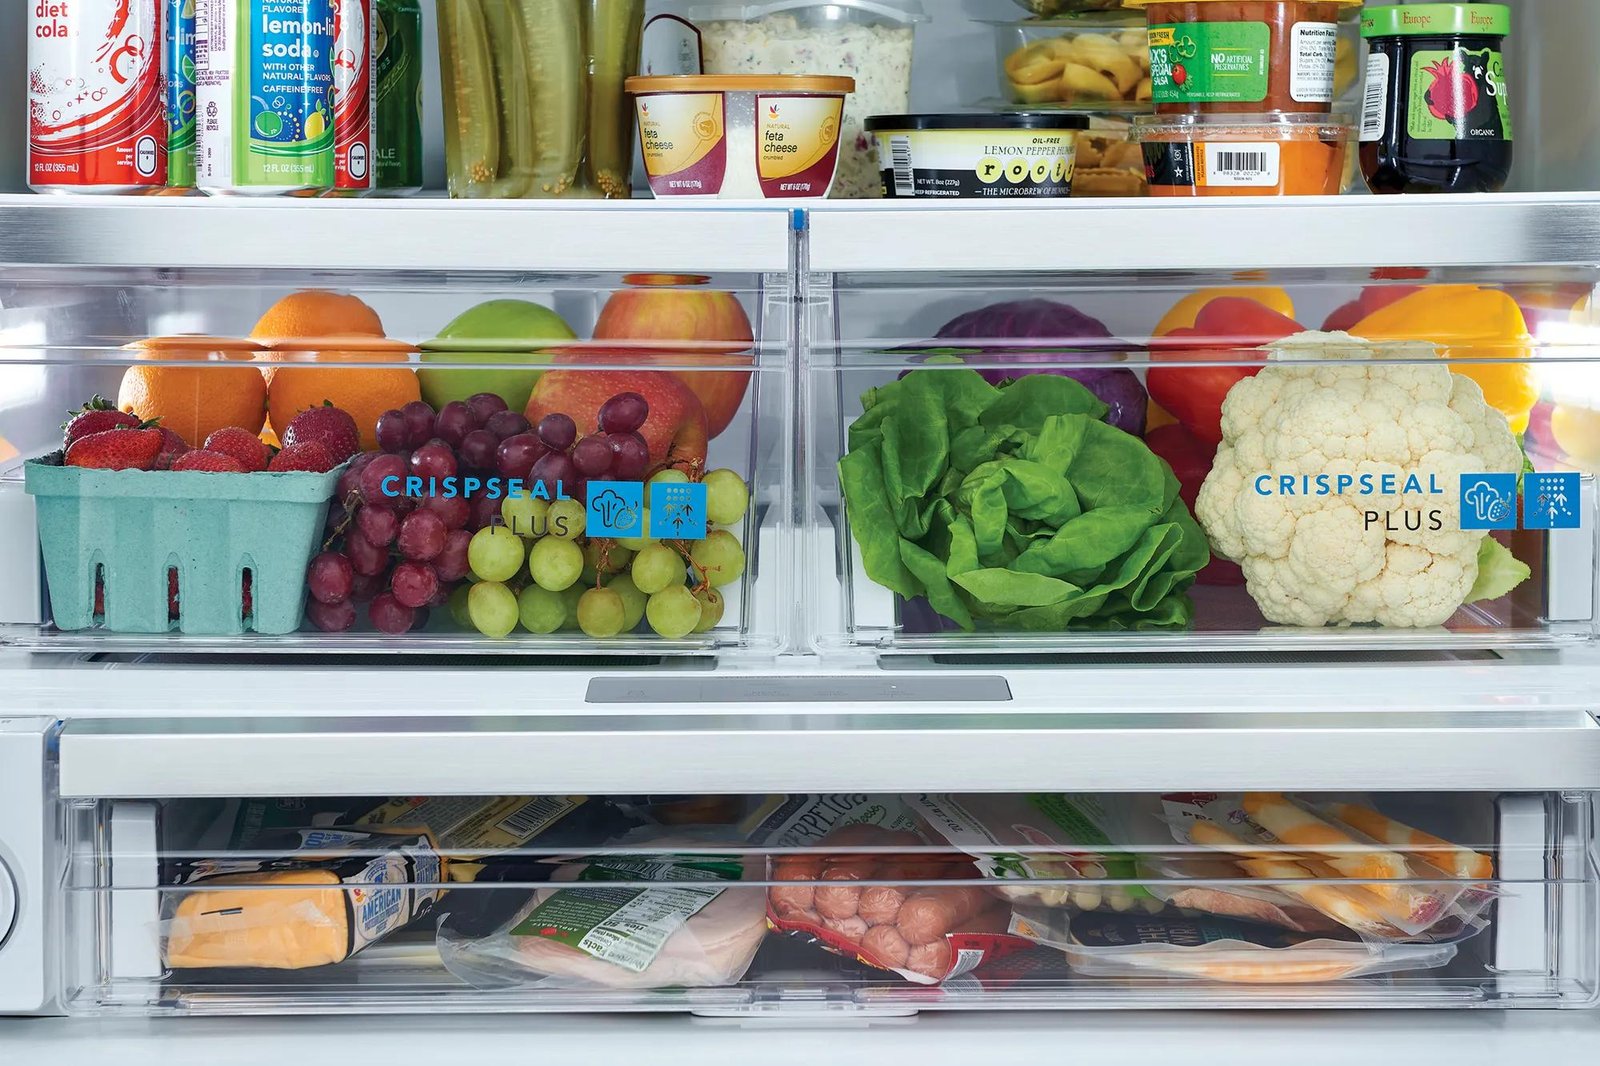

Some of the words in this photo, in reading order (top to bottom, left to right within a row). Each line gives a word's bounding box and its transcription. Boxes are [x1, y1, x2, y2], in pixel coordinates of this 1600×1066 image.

[36, 0, 68, 17] diet
[1402, 12, 1431, 28] Europe
[36, 19, 68, 37] cola
[262, 38, 312, 58] soda
[1210, 53, 1226, 64] NO
[1226, 55, 1253, 64] ARTIFICIAL
[262, 63, 287, 71] WITH
[288, 63, 315, 72] OTHER
[262, 72, 304, 80] NATURAL
[305, 73, 331, 82] FLAVORS
[1153, 76, 1169, 86] SALSA
[262, 85, 307, 94] CAFFEINE
[307, 86, 324, 94] FREE
[644, 128, 659, 139] feta
[765, 130, 784, 142] feta
[645, 139, 674, 150] cheese
[764, 142, 798, 153] cheese
[984, 145, 1024, 156] LEMON
[1026, 146, 1056, 156] PEPPER
[982, 187, 998, 196] THE
[999, 187, 1042, 196] MICROBREW
[381, 475, 571, 500] CRISPSEAL
[1254, 473, 1444, 496] CRISPSEAL
[490, 515, 569, 537] PLUS
[1363, 510, 1443, 532] PLUS
[362, 888, 402, 923] AMERICAN
